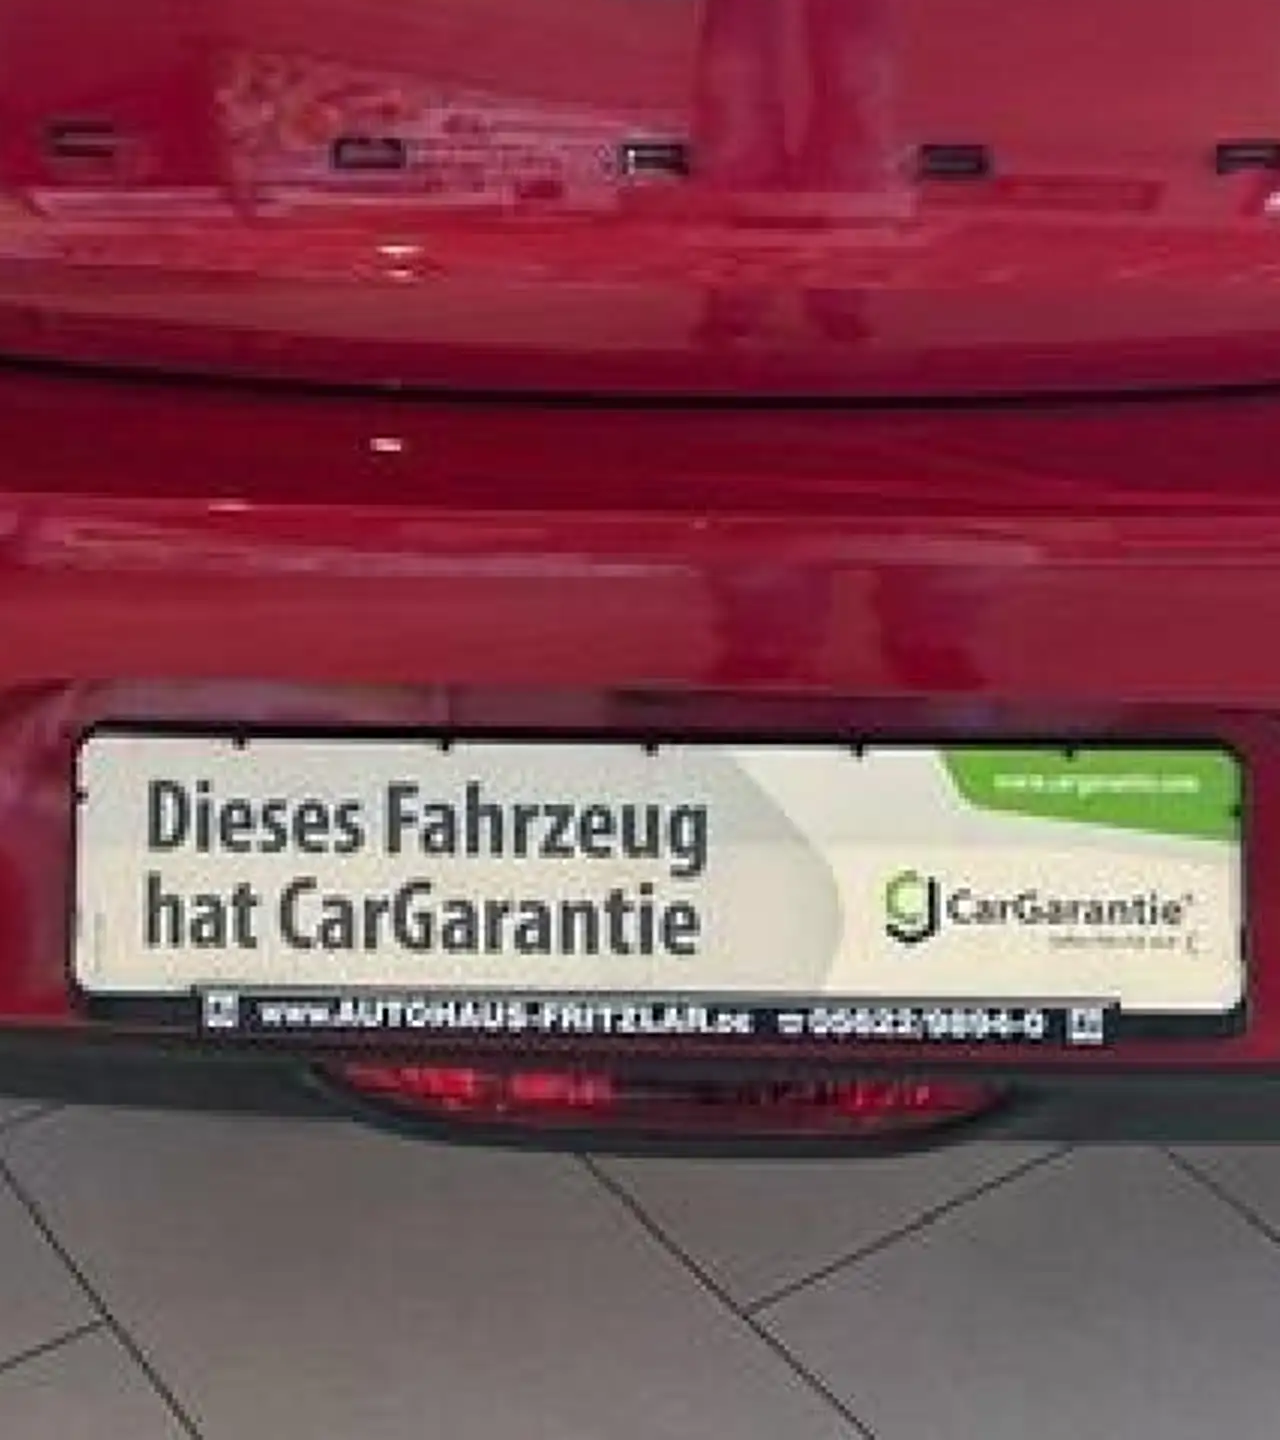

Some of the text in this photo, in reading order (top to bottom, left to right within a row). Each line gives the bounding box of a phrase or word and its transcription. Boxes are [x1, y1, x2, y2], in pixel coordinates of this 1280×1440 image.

[147, 778, 709, 878] Dieses Fahrzeug
[145, 869, 259, 950] hat
[278, 874, 702, 956] CarGarantie
[946, 887, 1182, 925] CarGarantie
